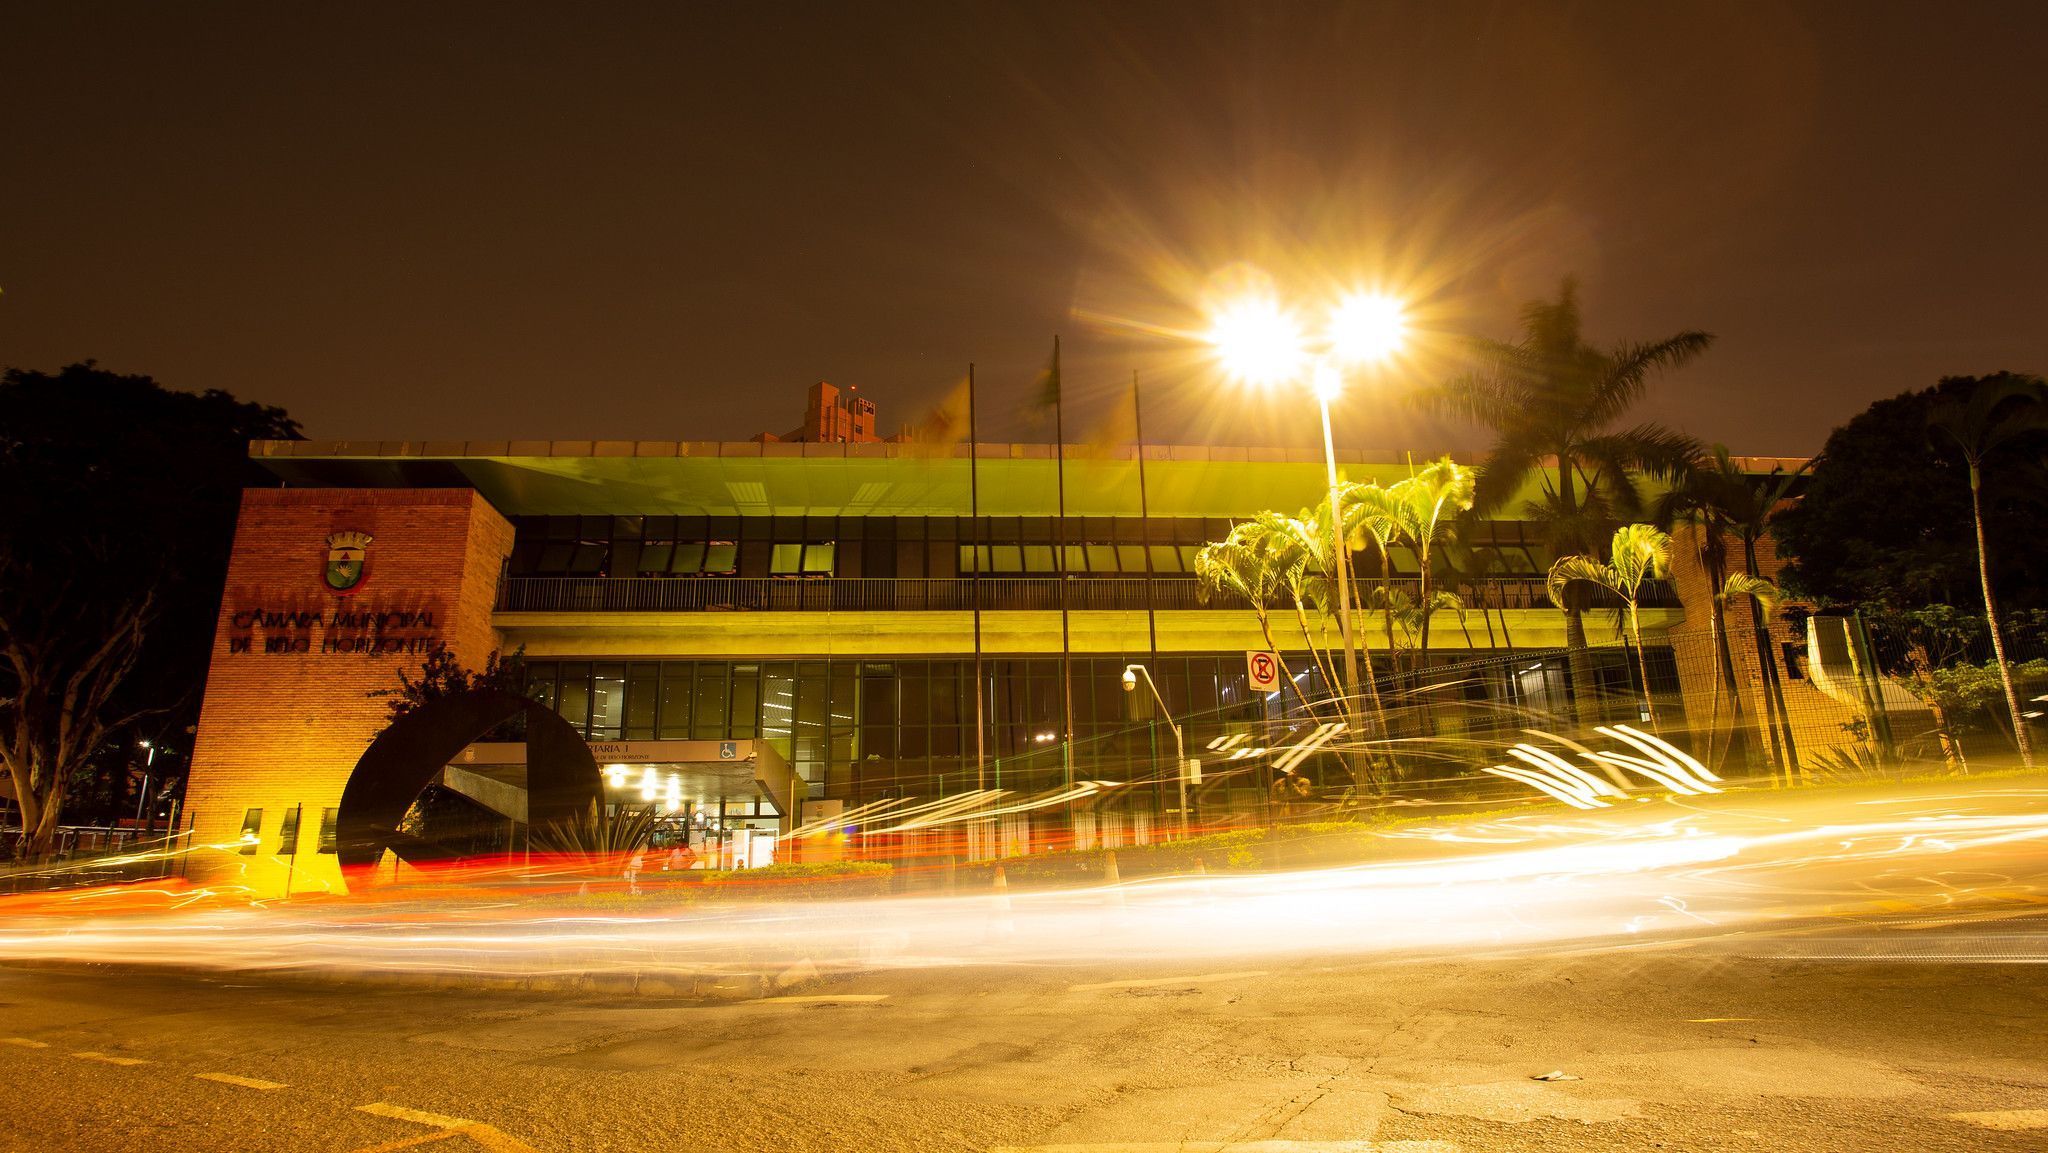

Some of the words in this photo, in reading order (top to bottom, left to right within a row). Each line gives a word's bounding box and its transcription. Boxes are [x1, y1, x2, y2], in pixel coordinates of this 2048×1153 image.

[232, 608, 324, 629] CÂMARA
[332, 612, 438, 630] MUNICIPAL
[230, 637, 251, 654] DE
[264, 637, 309, 654] BELO
[321, 637, 435, 655] HORIZONTE
